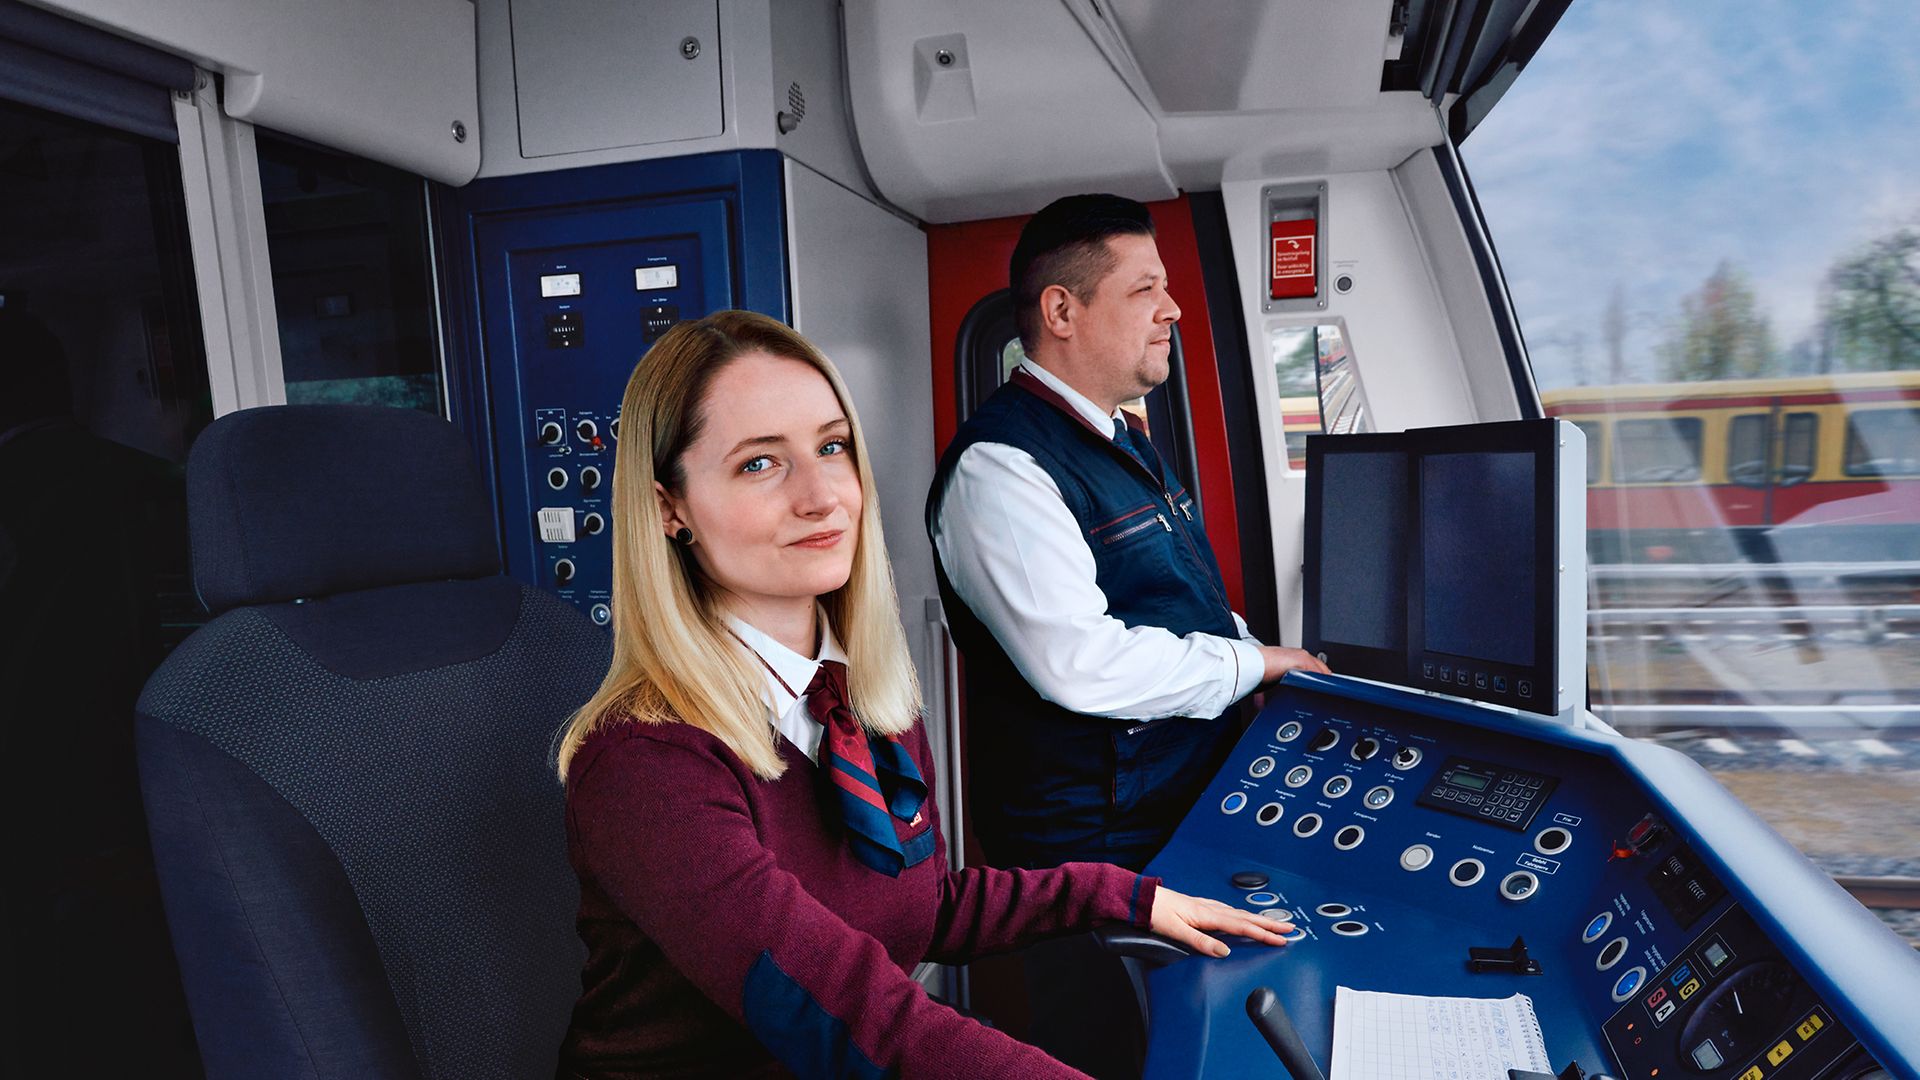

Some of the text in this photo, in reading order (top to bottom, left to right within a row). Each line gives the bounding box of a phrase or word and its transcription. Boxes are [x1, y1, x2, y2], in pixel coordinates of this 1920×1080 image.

[1683, 982, 1696, 996] G
[1650, 991, 1663, 1004] S
[1658, 1005, 1671, 1019] A
